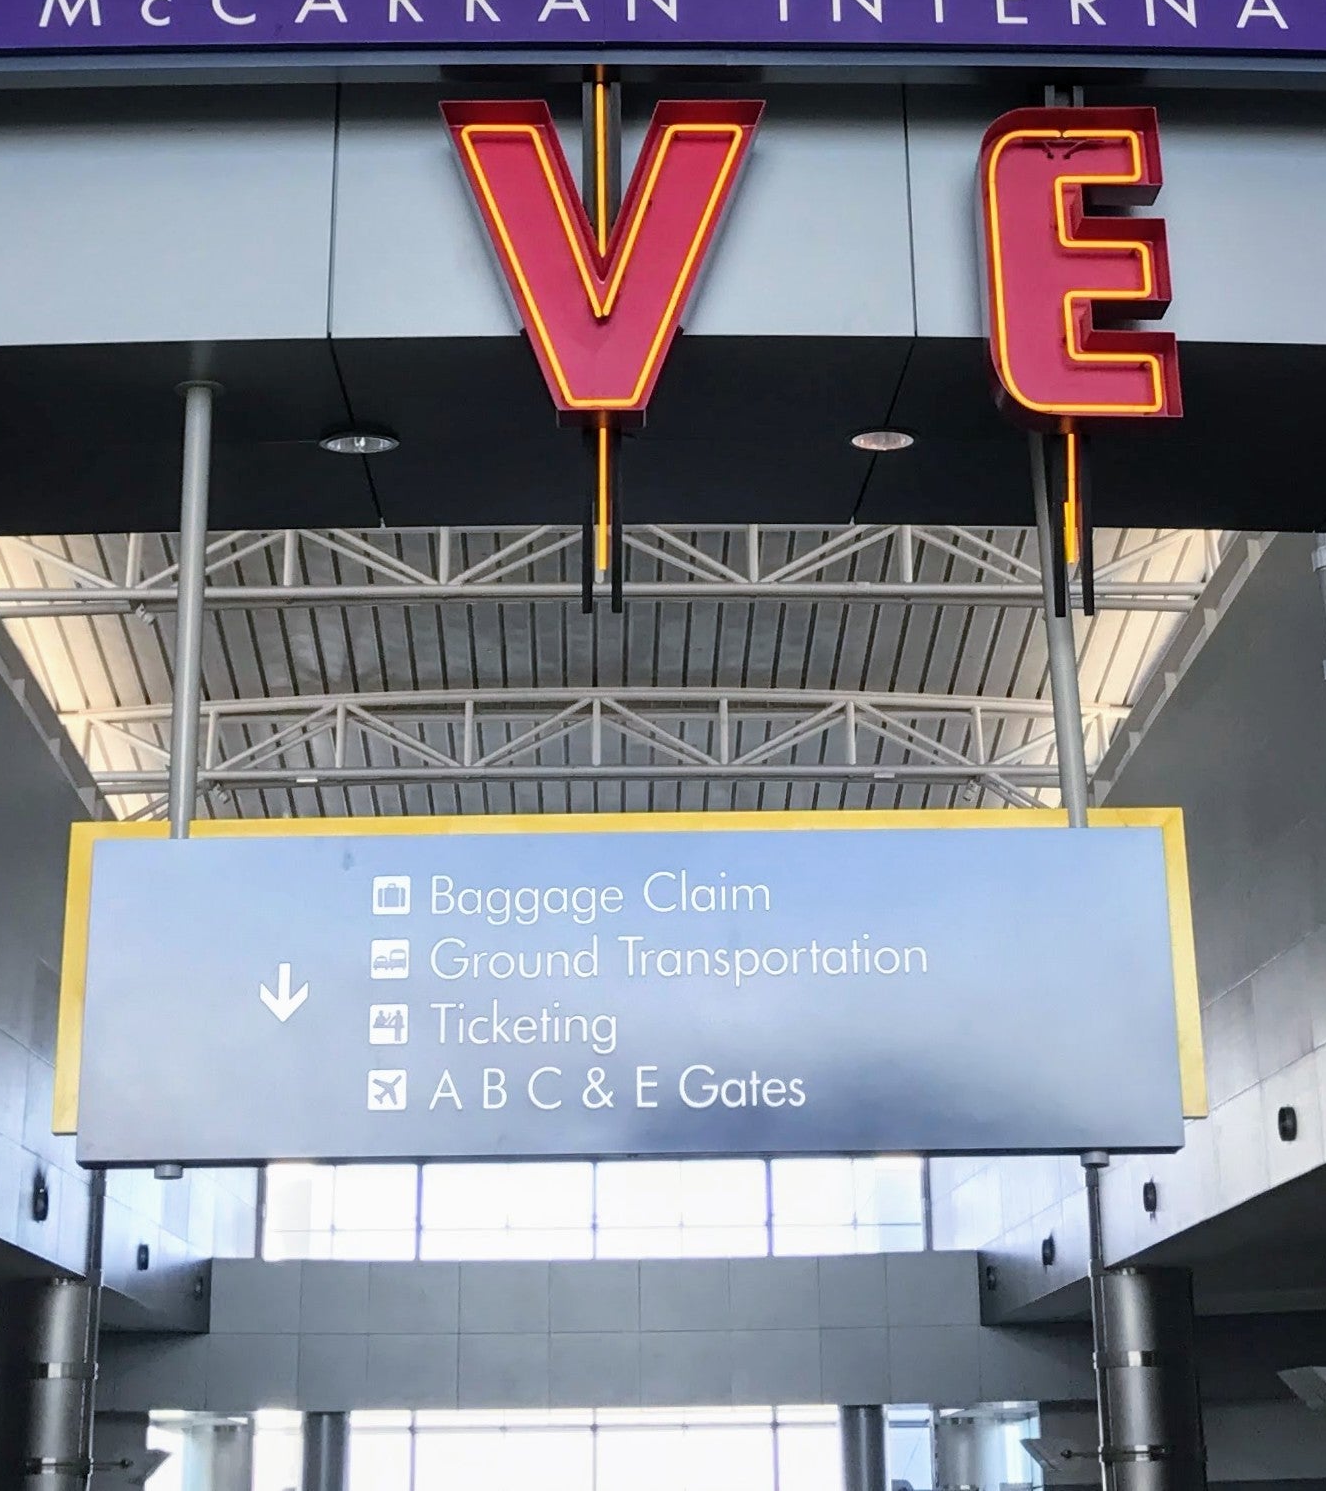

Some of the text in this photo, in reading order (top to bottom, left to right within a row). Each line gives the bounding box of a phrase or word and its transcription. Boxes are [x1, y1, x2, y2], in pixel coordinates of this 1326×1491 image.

[430, 869, 772, 927] Baggage Claim
[429, 933, 929, 988] Ground Transportation
[429, 997, 618, 1055] Ticketing
[428, 1063, 808, 1111] A B C & E Gates
